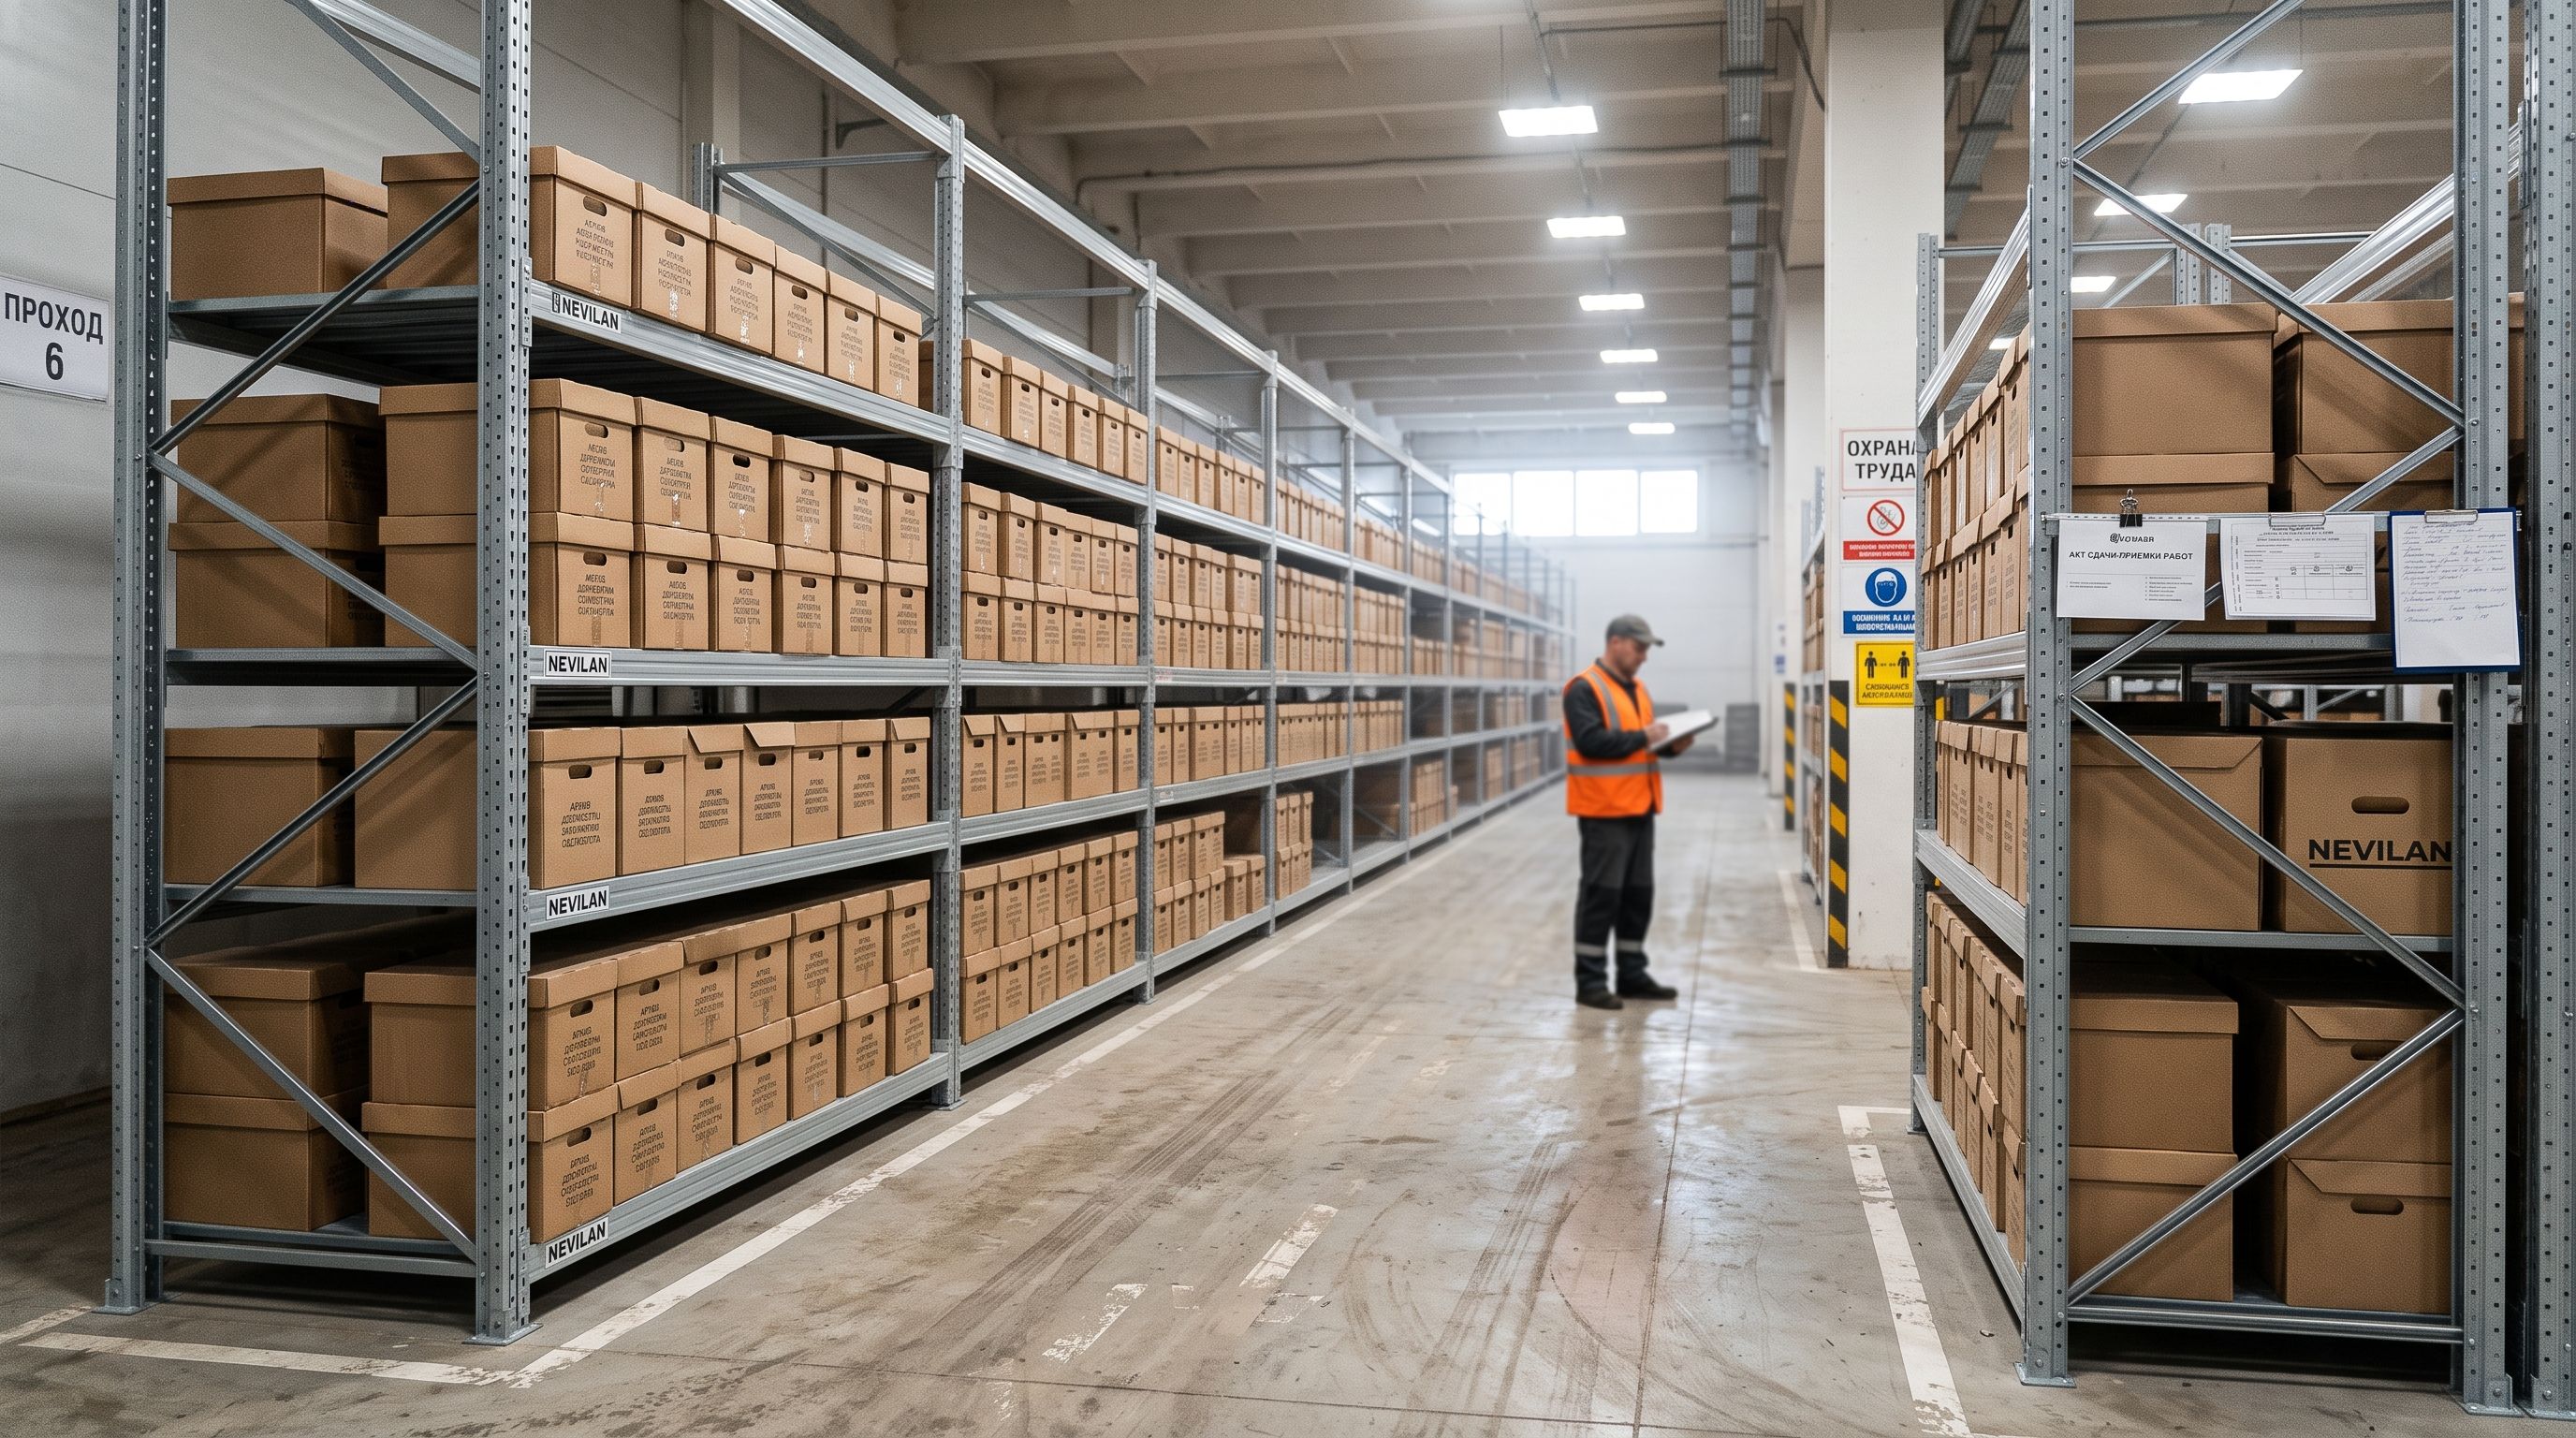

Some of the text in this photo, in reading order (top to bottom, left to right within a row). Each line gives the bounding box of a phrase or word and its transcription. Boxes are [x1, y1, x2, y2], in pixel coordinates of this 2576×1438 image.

[5, 292, 103, 345] ПРОХОД
[563, 297, 619, 330] NEVILAN
[45, 342, 64, 380] 6
[1854, 462, 1916, 482] ТРУДА
[549, 655, 607, 673] NEVILAN
[2308, 839, 2452, 862] NEVILAN
[549, 889, 607, 917] NEVILAN
[549, 1221, 606, 1263] NEVILAN
